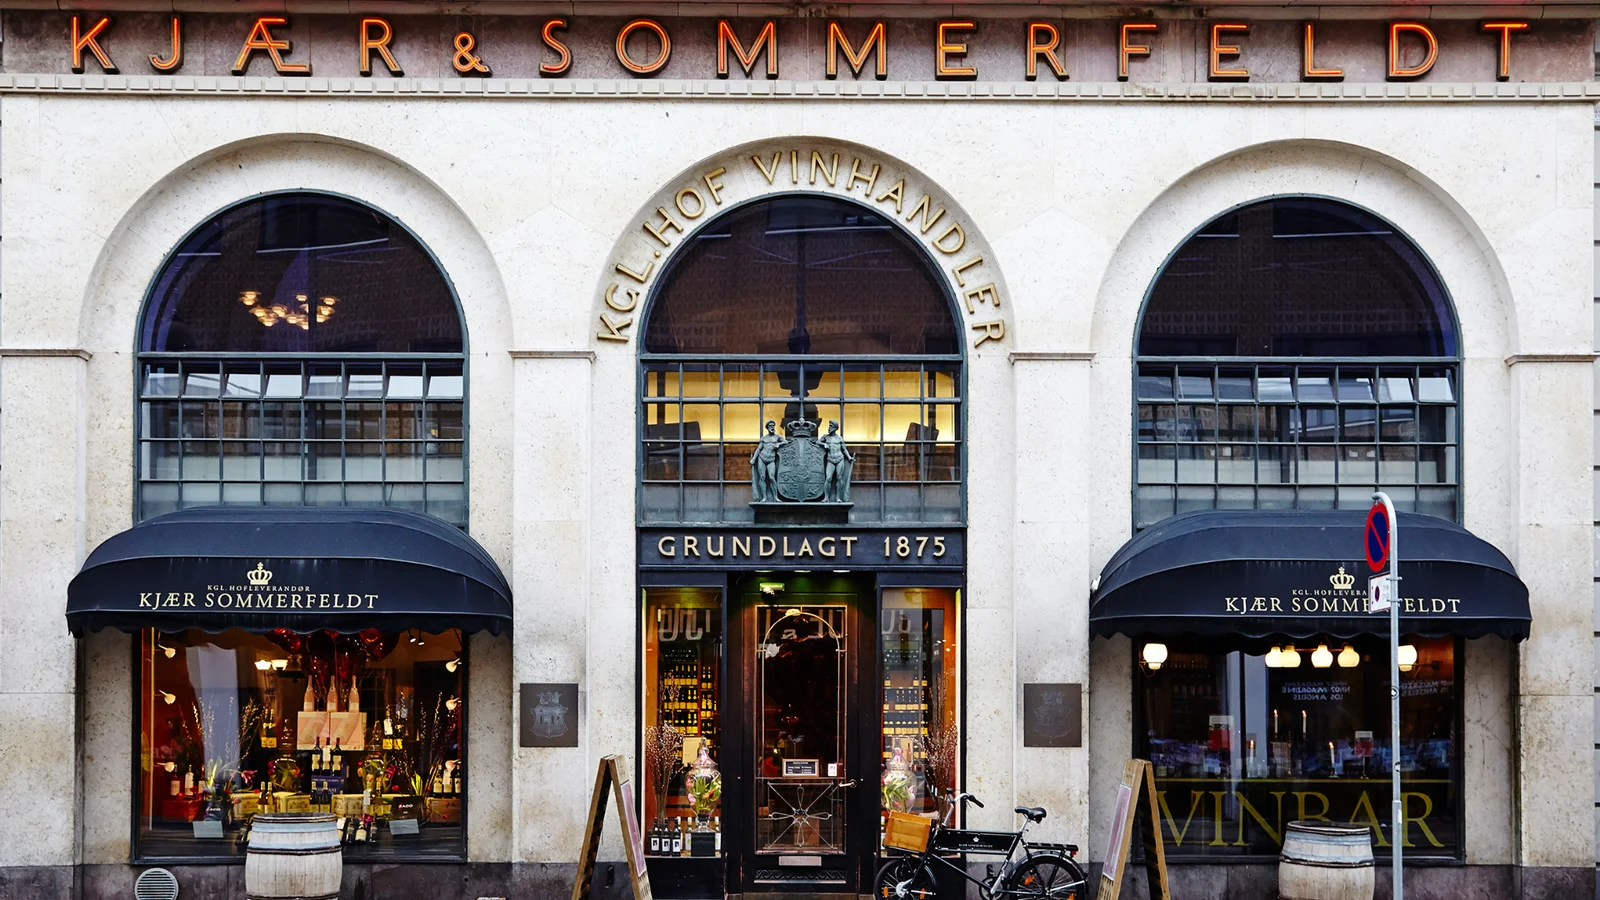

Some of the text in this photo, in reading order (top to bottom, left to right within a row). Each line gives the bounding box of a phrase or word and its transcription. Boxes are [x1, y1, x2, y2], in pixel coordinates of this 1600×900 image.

[70, 15, 1530, 82] KJÆR & SOMMERFELDT
[751, 150, 1006, 349] VINHANDLER
[657, 535, 947, 558] GRUNDLAGT 1875
[139, 593, 379, 610] KJÆR SOMMERFELDT
[1225, 597, 1461, 615] KJÆR SOMMEELDT
[1157, 790, 1445, 848] VINBAR
